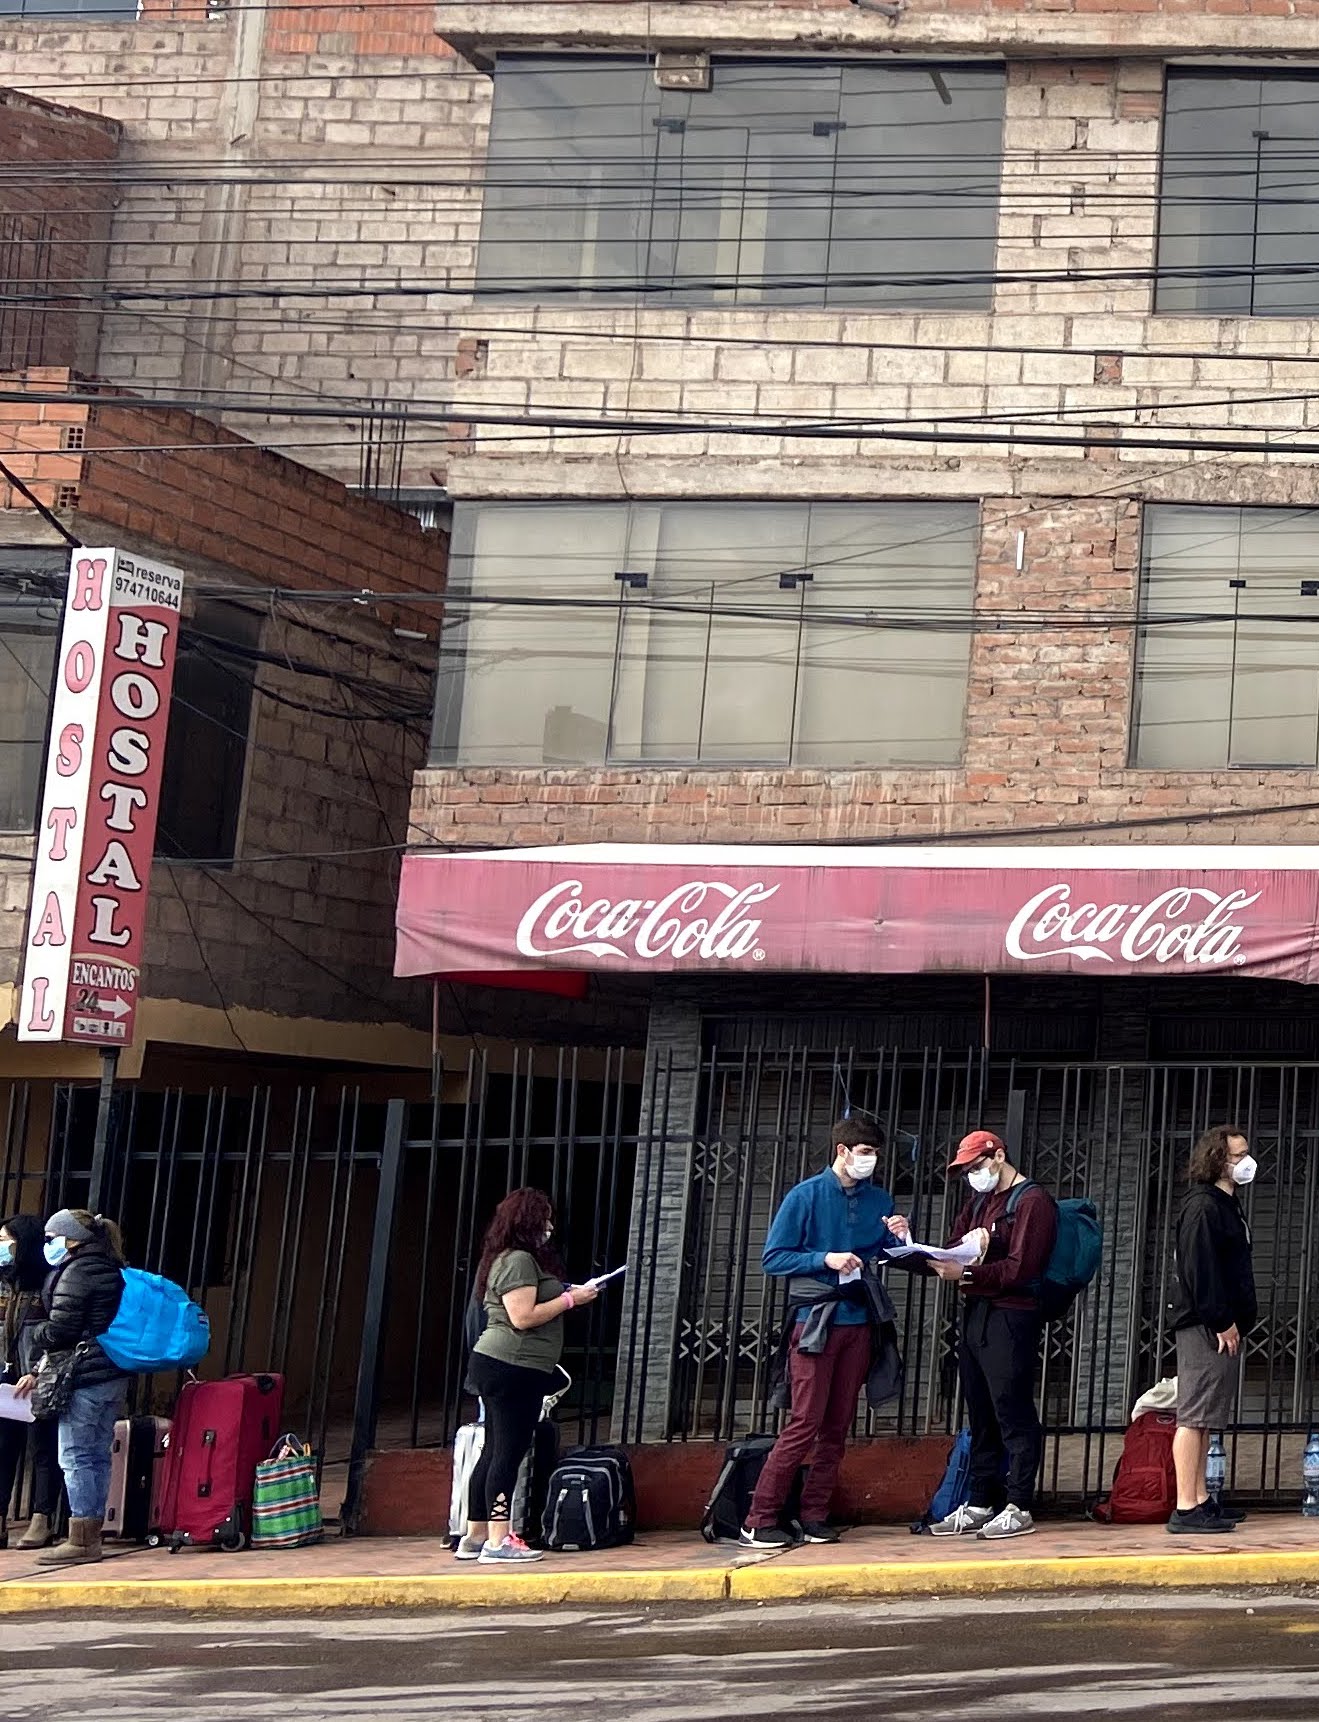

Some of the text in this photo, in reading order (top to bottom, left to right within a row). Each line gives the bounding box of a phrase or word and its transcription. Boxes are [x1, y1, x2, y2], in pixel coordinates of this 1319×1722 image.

[115, 576, 179, 609] 974710644
[136, 567, 181, 591] reserva
[27, 558, 105, 1034] HOSTAL
[86, 612, 169, 948] HOSTAL
[72, 962, 136, 992] ENCANTOS
